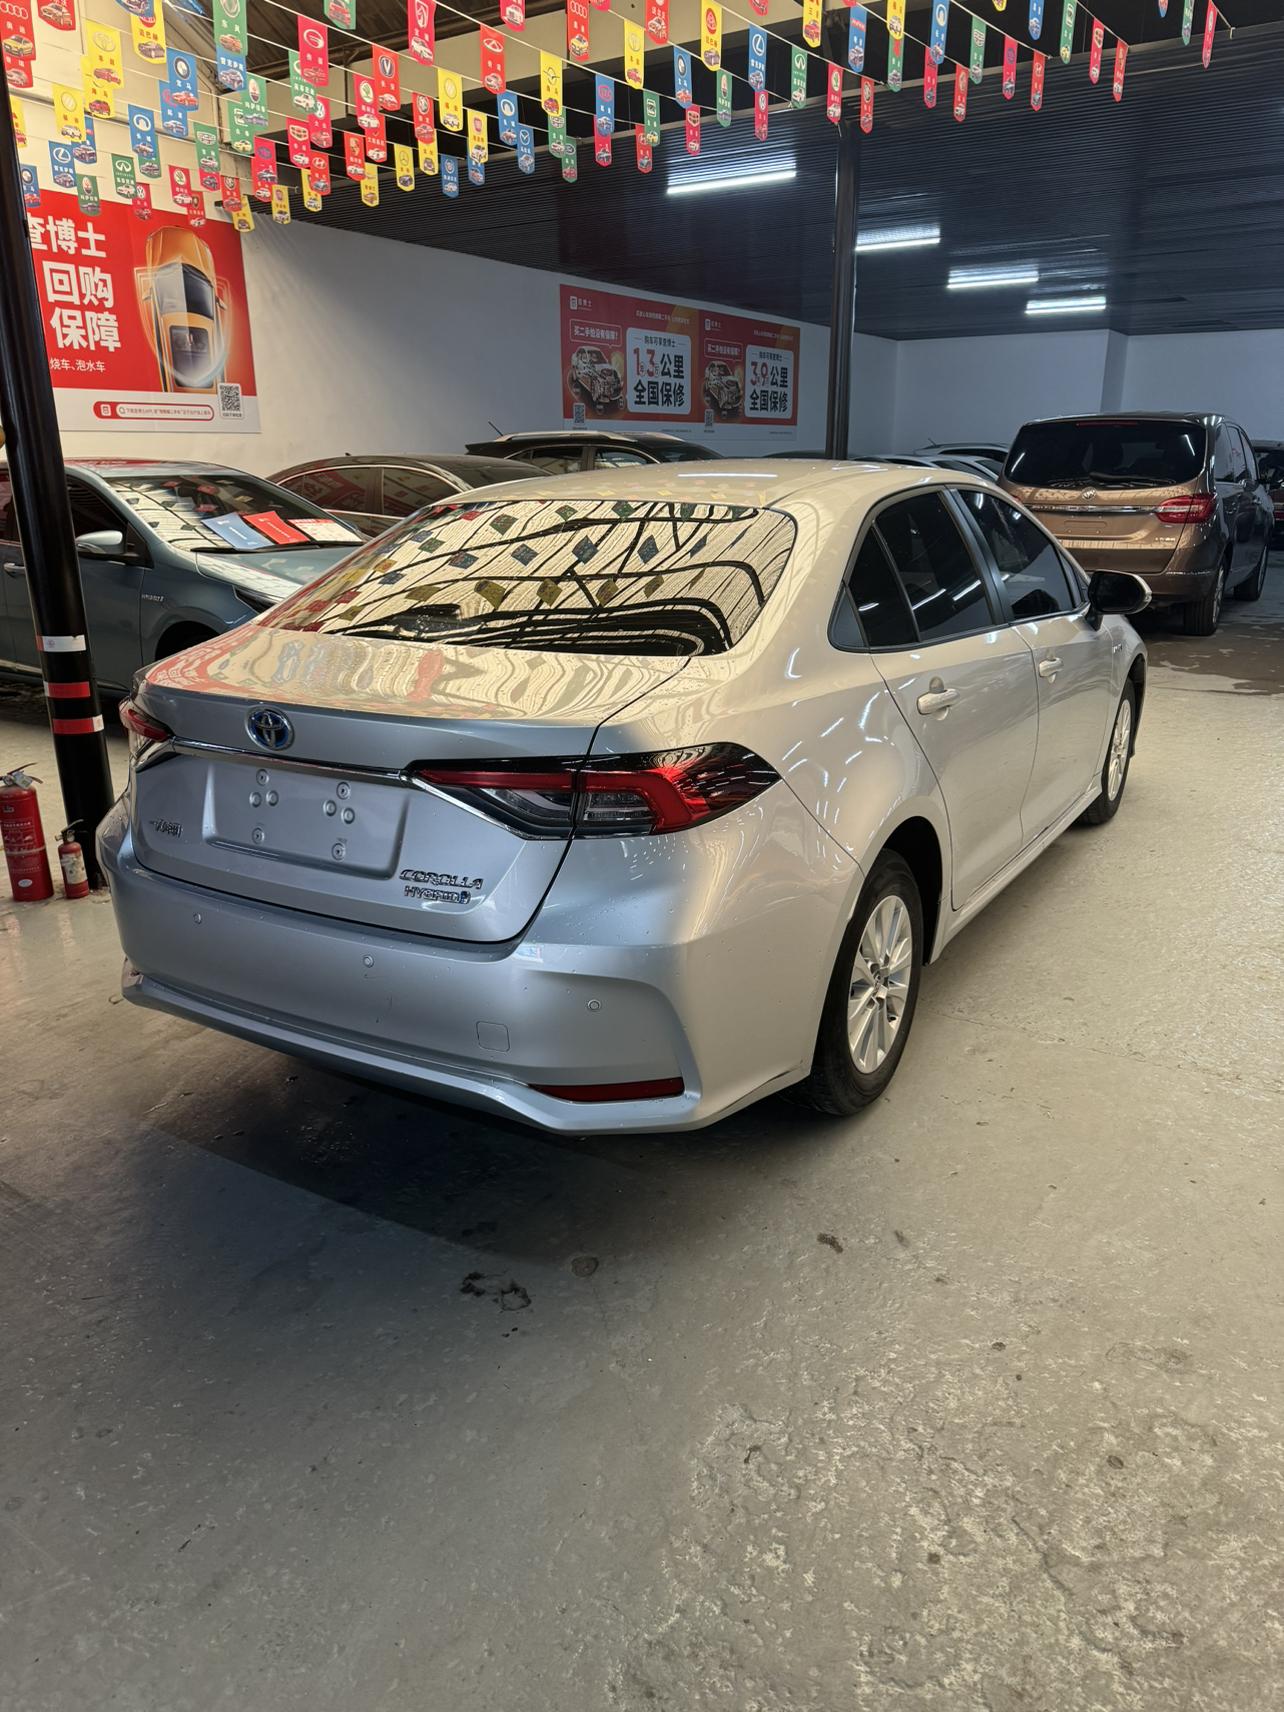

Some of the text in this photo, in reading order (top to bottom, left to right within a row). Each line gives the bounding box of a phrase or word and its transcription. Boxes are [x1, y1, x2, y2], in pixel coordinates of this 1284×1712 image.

[42, 260, 114, 308] 回购
[50, 306, 121, 352] 保障
[633, 378, 685, 408] 全国保修
[749, 388, 789, 413] 全国保修
[399, 869, 484, 889] COROLLA
